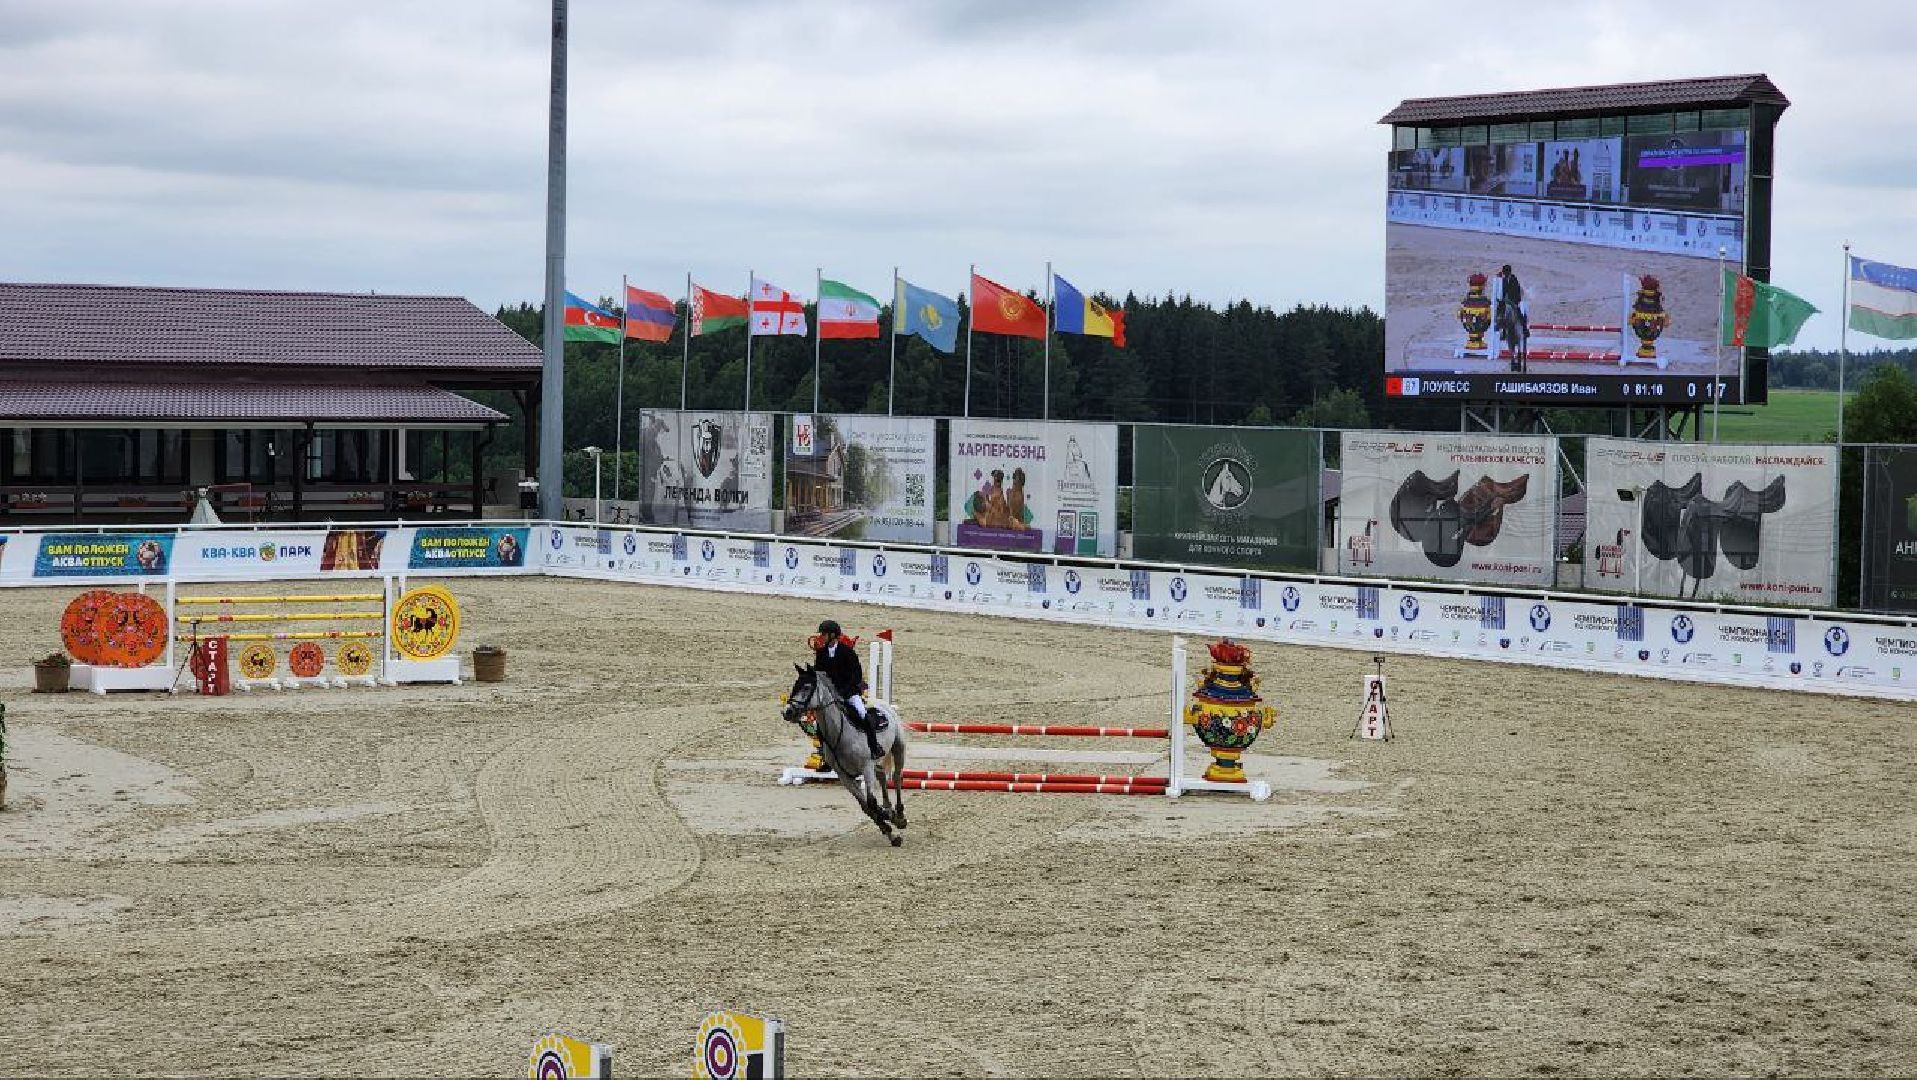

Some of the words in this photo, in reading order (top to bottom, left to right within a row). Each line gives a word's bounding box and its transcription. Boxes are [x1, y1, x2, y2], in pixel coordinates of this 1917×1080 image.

[1422, 380, 1470, 393] ЛОУЛЕСС
[1495, 382, 1568, 394] ГАШИБАЯЗОВ
[1571, 383, 1598, 394] Иван
[1622, 383, 1630, 396] 0
[1635, 383, 1663, 396] 81.10
[1688, 382, 1696, 397] 0
[957, 442, 1047, 462] ХАРПЕРСБЭНД
[664, 486, 711, 503] ЛЕГЕНДА
[714, 488, 749, 504] ВОЛГИ
[421, 536, 442, 547] ВАМ
[443, 536, 490, 547] ПОЛОЖЕН
[48, 545, 73, 556] ВАМ
[74, 544, 128, 555] ПОЛОЖЕН
[202, 548, 255, 559] КВА-КВА
[280, 545, 312, 557] ПАРК
[52, 556, 124, 567] АКВАОТПУСК
[1875, 636, 1917, 650] ЧЕМПИО
[207, 639, 219, 693] СТАРТ
[1367, 680, 1378, 737] СТАРТ
